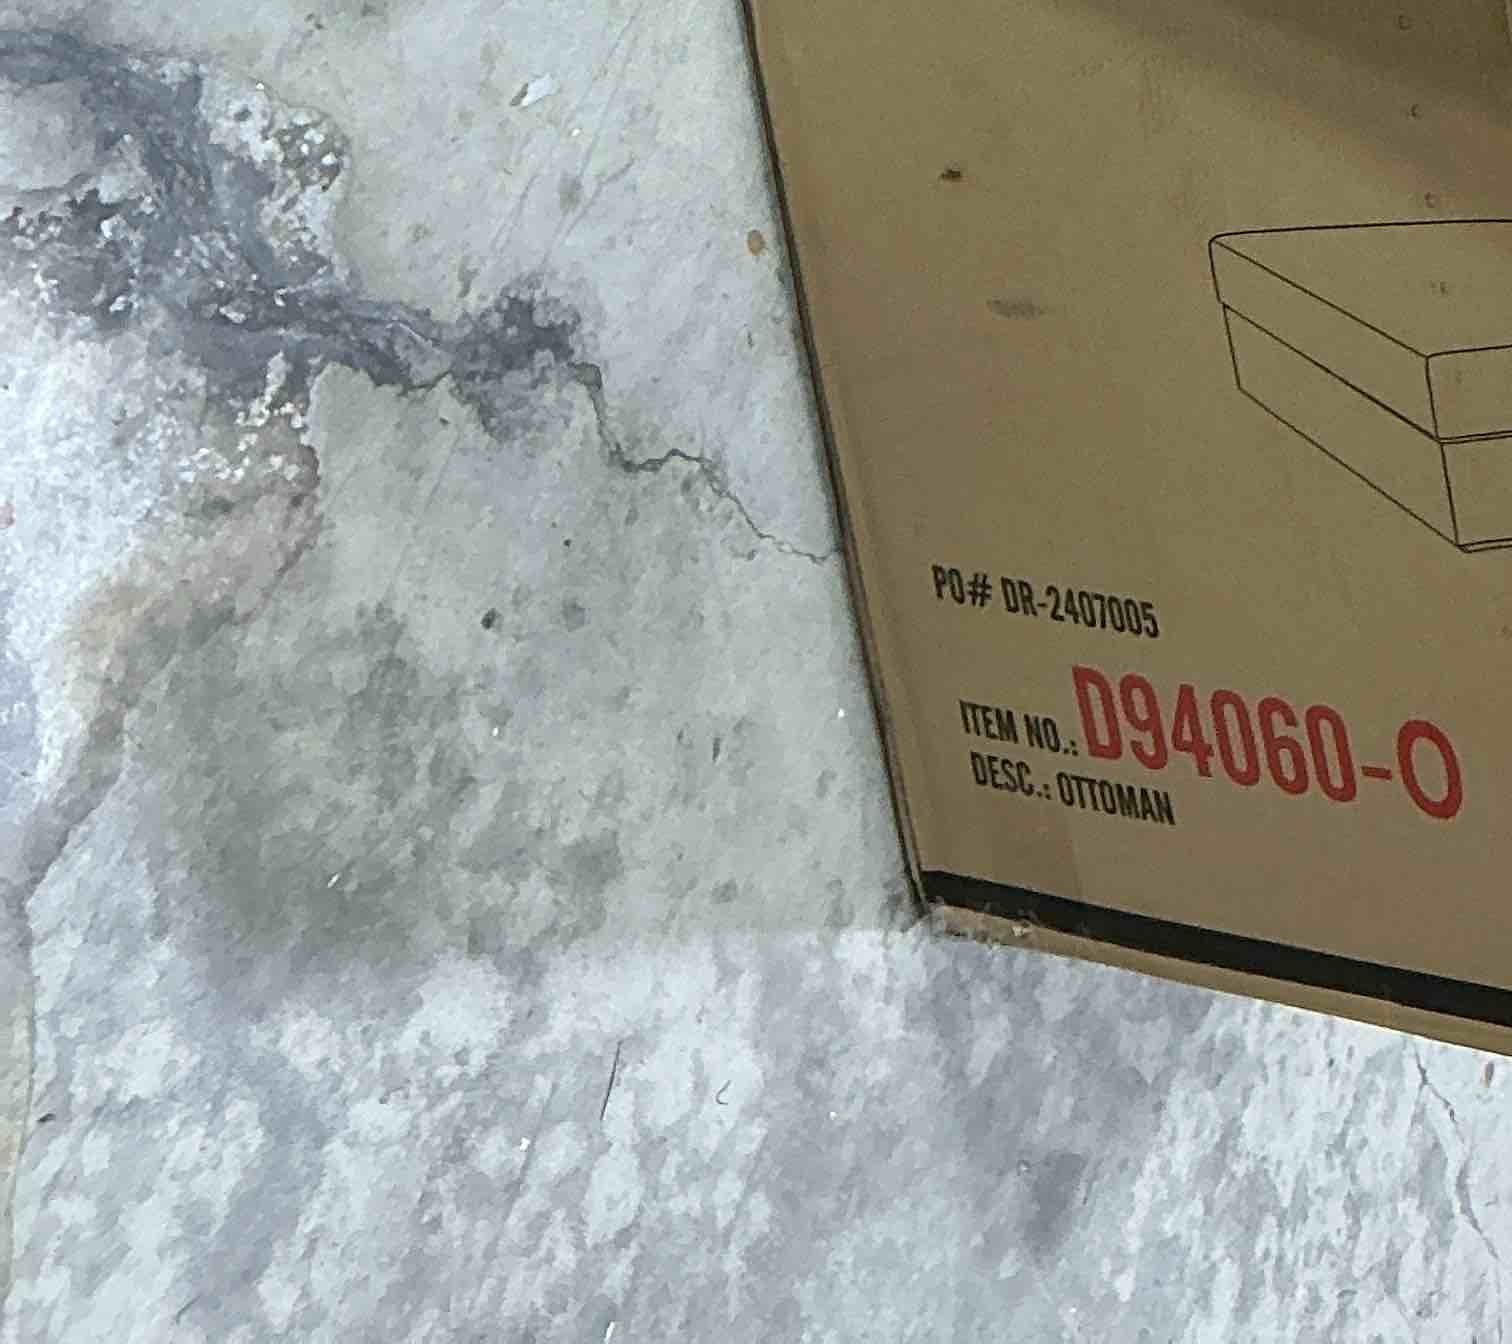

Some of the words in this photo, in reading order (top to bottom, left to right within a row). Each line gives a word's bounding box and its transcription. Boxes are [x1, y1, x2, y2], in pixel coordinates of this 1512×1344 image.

[930, 564, 993, 608] PO#
[1000, 576, 1160, 639] DR-2407005
[958, 698, 1018, 744] ITEM
[1071, 664, 1464, 820] D94060-O
[1055, 770, 1177, 827] OTTOMAN
